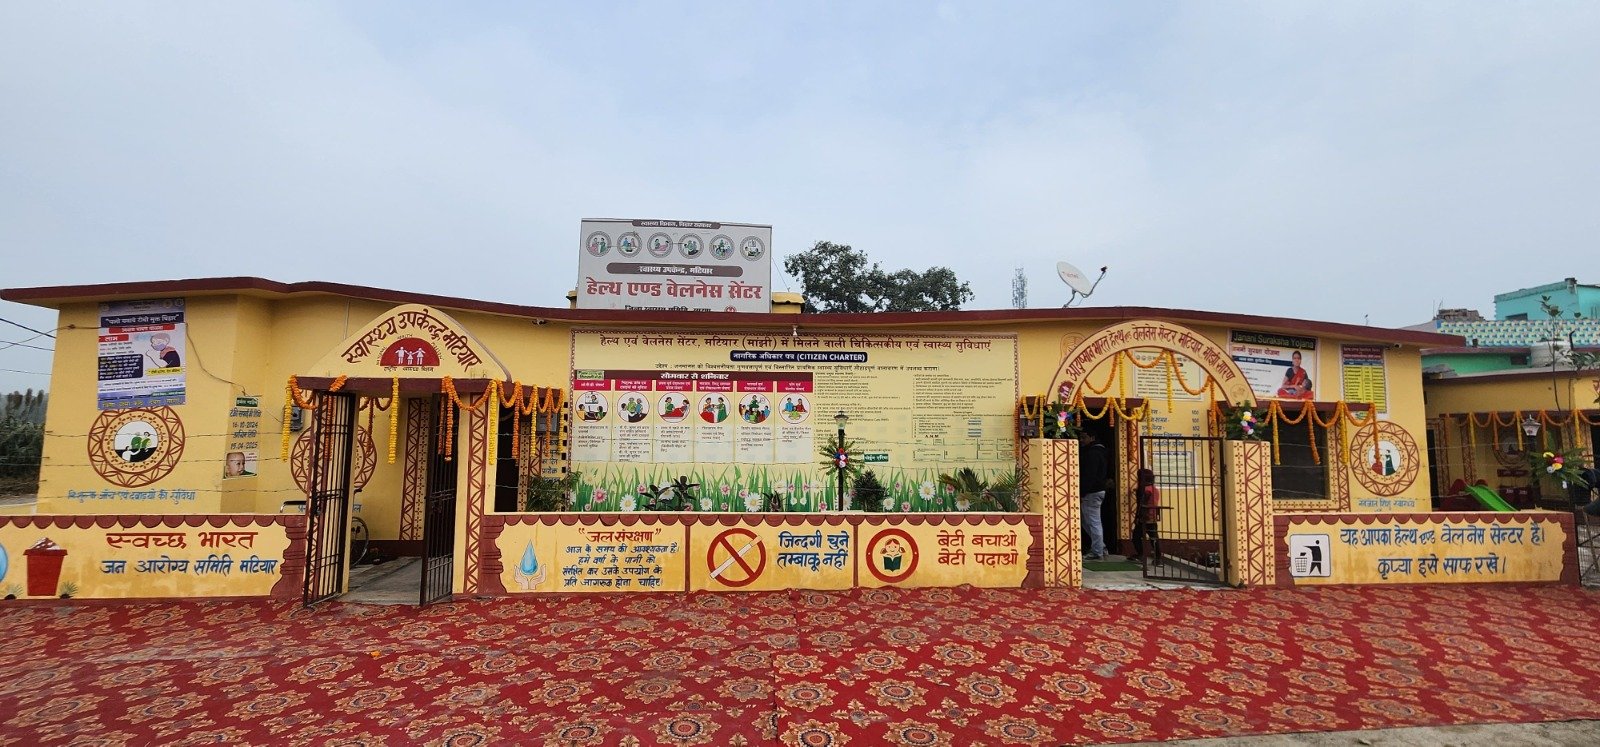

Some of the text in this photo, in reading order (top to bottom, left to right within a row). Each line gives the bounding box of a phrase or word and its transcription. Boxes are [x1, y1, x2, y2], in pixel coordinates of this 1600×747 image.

[586, 277, 762, 299] हेल्थ एण्ड वेलनेस सेंटर
[1132, 324, 1158, 341] वेलनेस
[1234, 331, 1314, 349] Janani Suraksha Yojana
[341, 316, 398, 364] स्वास्थ्य
[443, 330, 482, 372] मटियार
[600, 335, 619, 346] हेल्थ
[624, 335, 638, 347] एवं
[642, 335, 673, 346] वेलनेस
[704, 336, 738, 347] मटियार
[780, 336, 789, 347] में
[793, 336, 819, 348] मिलने
[824, 338, 846, 348] वाली
[850, 338, 902, 349] चिकित्सकीय
[906, 339, 920, 350] एवं
[924, 340, 951, 349] स्वास्थ्य
[733, 352, 757, 360] नागरिक
[785, 353, 794, 361] पत्र
[796, 353, 828, 362] (CITIZEN
[829, 354, 866, 362] CHARTER)
[1248, 347, 1262, 356] सुरक्षा
[1264, 348, 1280, 356] योजना
[691, 372, 698, 380] से
[700, 372, 729, 380] शनिवार
[106, 531, 258, 548] स्वच्छ भारत
[779, 530, 850, 548] जिन्दगी चुने
[937, 529, 1018, 547] बेटी बचाओ
[1340, 529, 1358, 547] यह
[1360, 529, 1391, 547] आपका
[1394, 525, 1419, 546] हेल्थ
[1441, 524, 1486, 546] वेलनेस
[1490, 524, 1524, 546] सेन्टर
[565, 546, 582, 554] आज
[585, 544, 592, 553] के
[618, 544, 627, 553] की
[631, 546, 668, 554] आवश्यकता
[100, 554, 278, 577] जन आरोग्य समिति मटियार
[592, 554, 607, 564] वर्षा
[610, 554, 618, 563] के
[625, 554, 643, 564] पानी
[646, 555, 656, 563] को
[777, 550, 849, 573] तम्बाकू नहीं
[937, 548, 1019, 569] बेटी पढ़ाओ
[562, 565, 662, 576] संरक्षित कर उसके उपयोग के
[1378, 558, 1413, 581] कृप्या
[1418, 554, 1438, 575] इसे
[1443, 558, 1472, 575] साफ
[563, 576, 577, 588] प्रति
